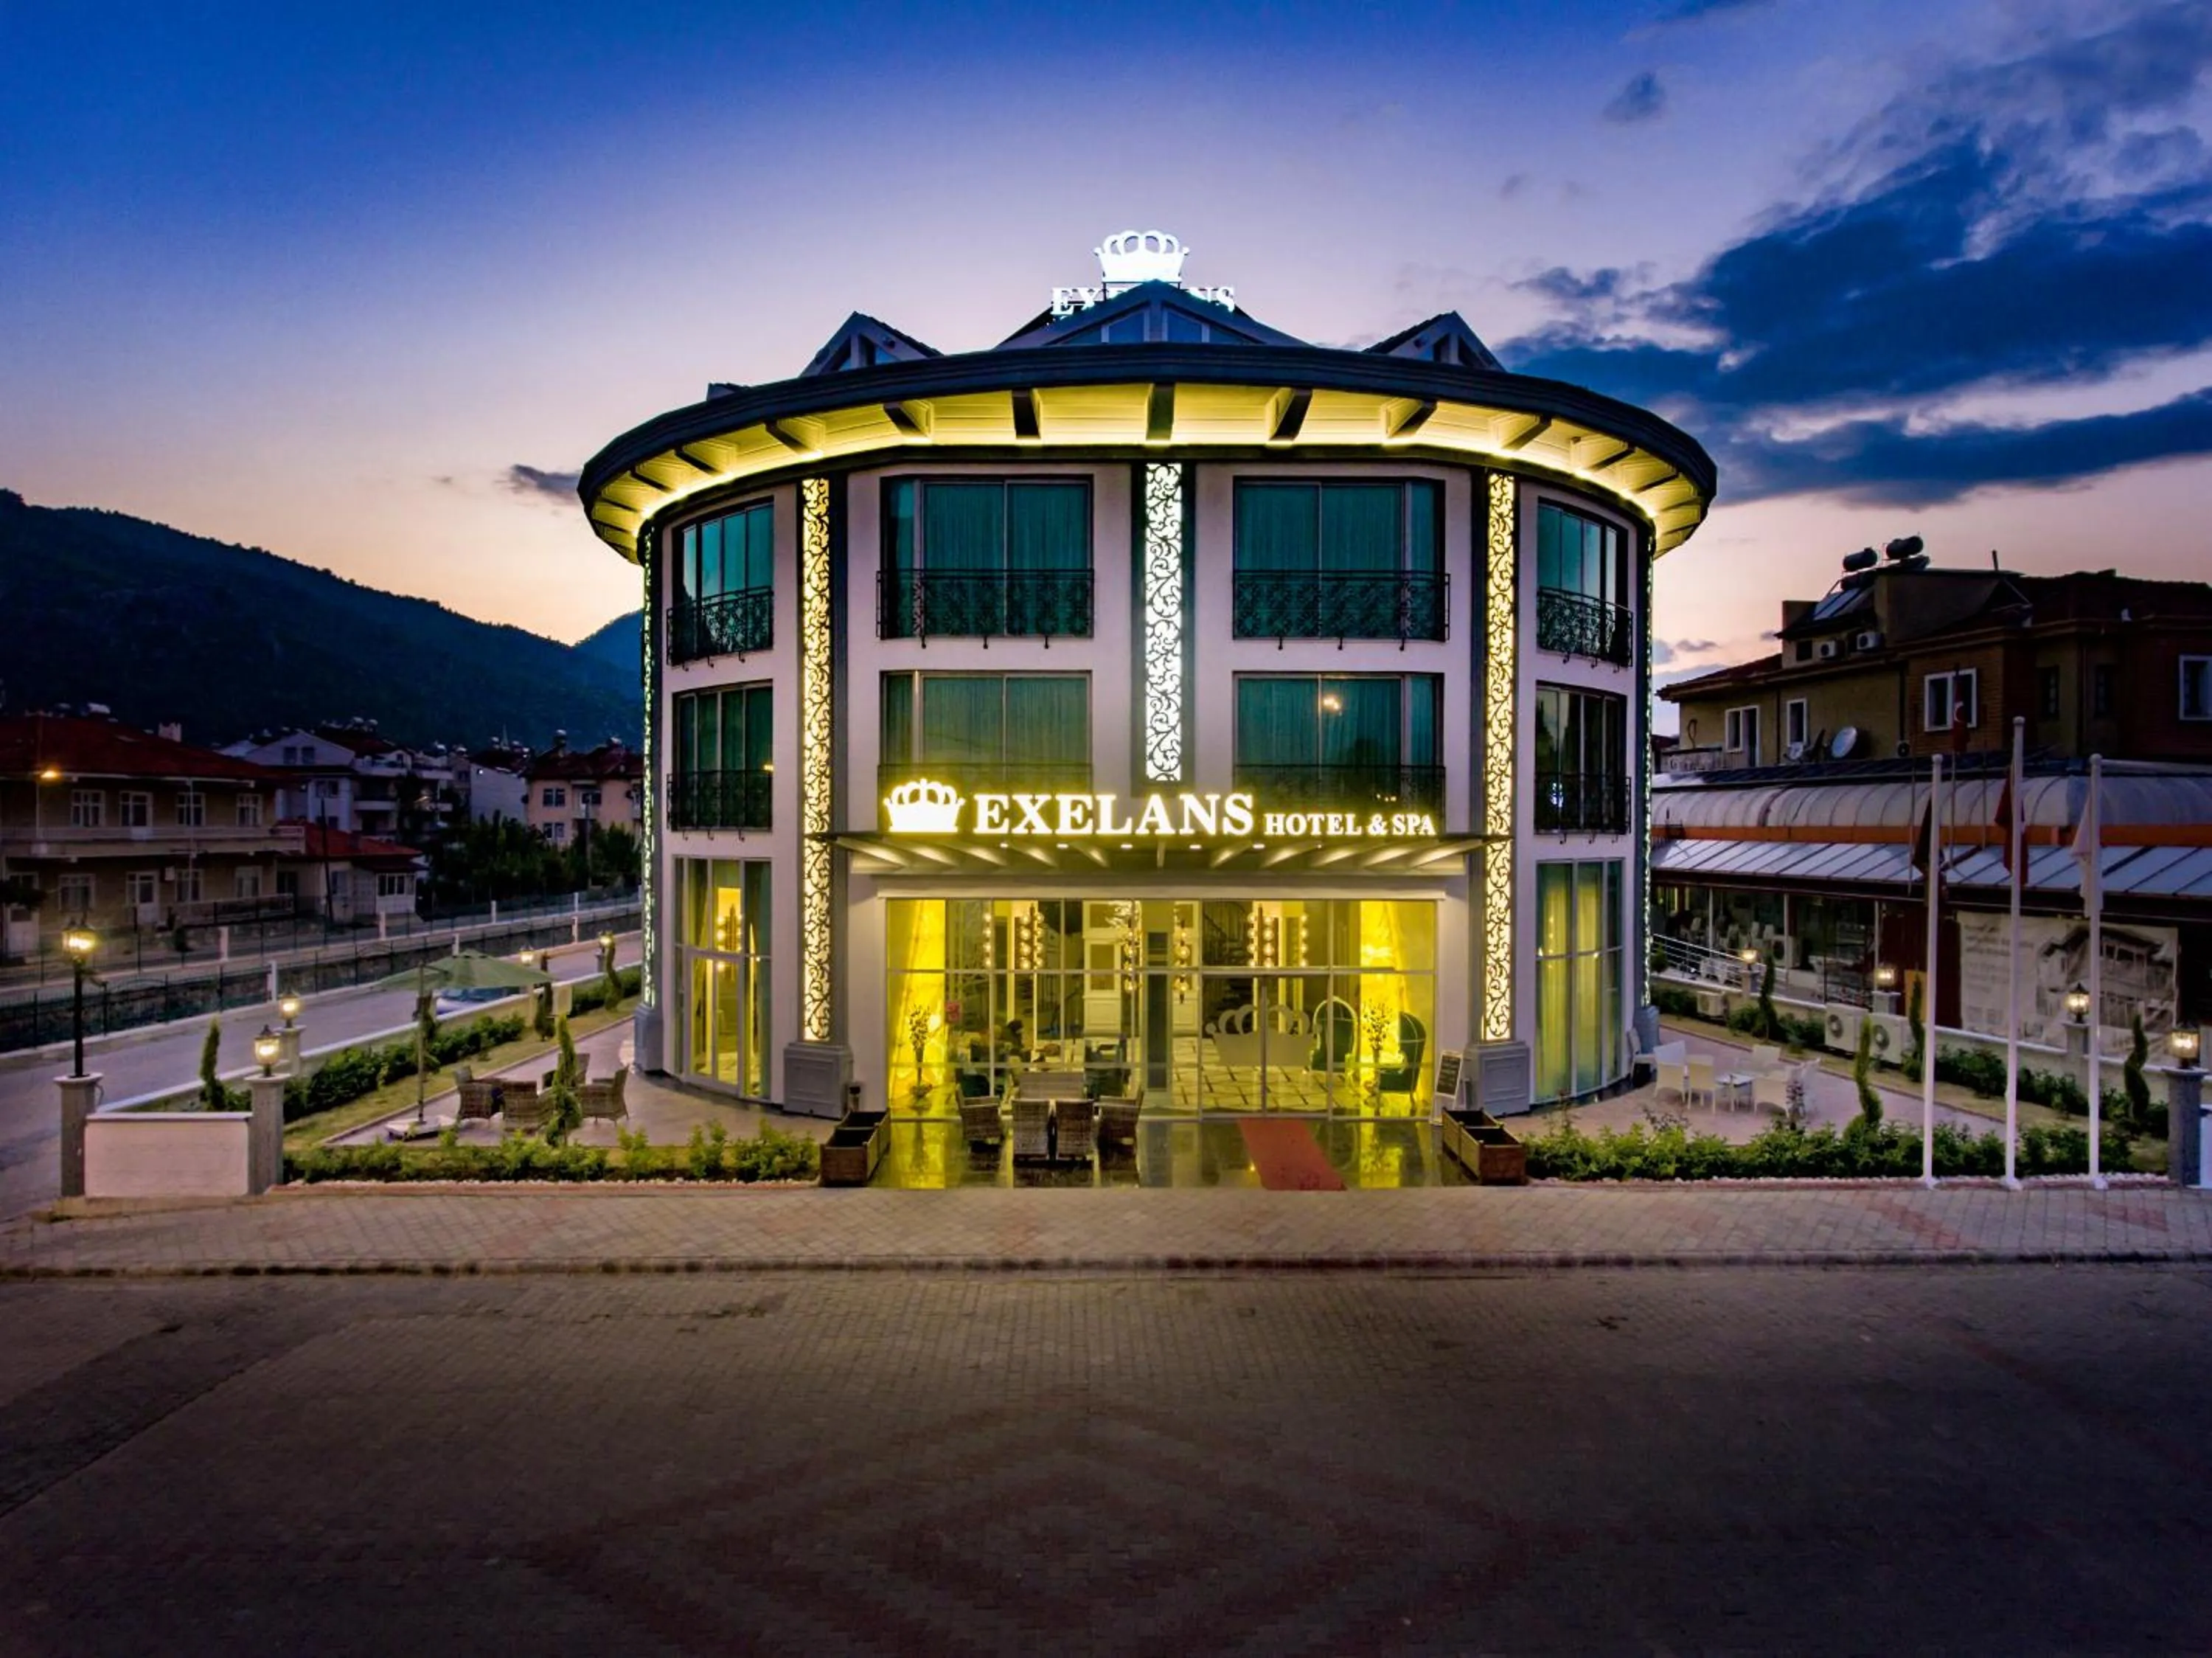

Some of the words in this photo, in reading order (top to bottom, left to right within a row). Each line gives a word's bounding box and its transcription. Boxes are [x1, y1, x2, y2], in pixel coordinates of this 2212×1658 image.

[1050, 287, 1235, 315] EXNS
[973, 793, 1254, 836] EXELANS
[1264, 813, 1362, 836] HOTEL
[1368, 814, 1388, 836] &
[1392, 814, 1436, 836] SPA
